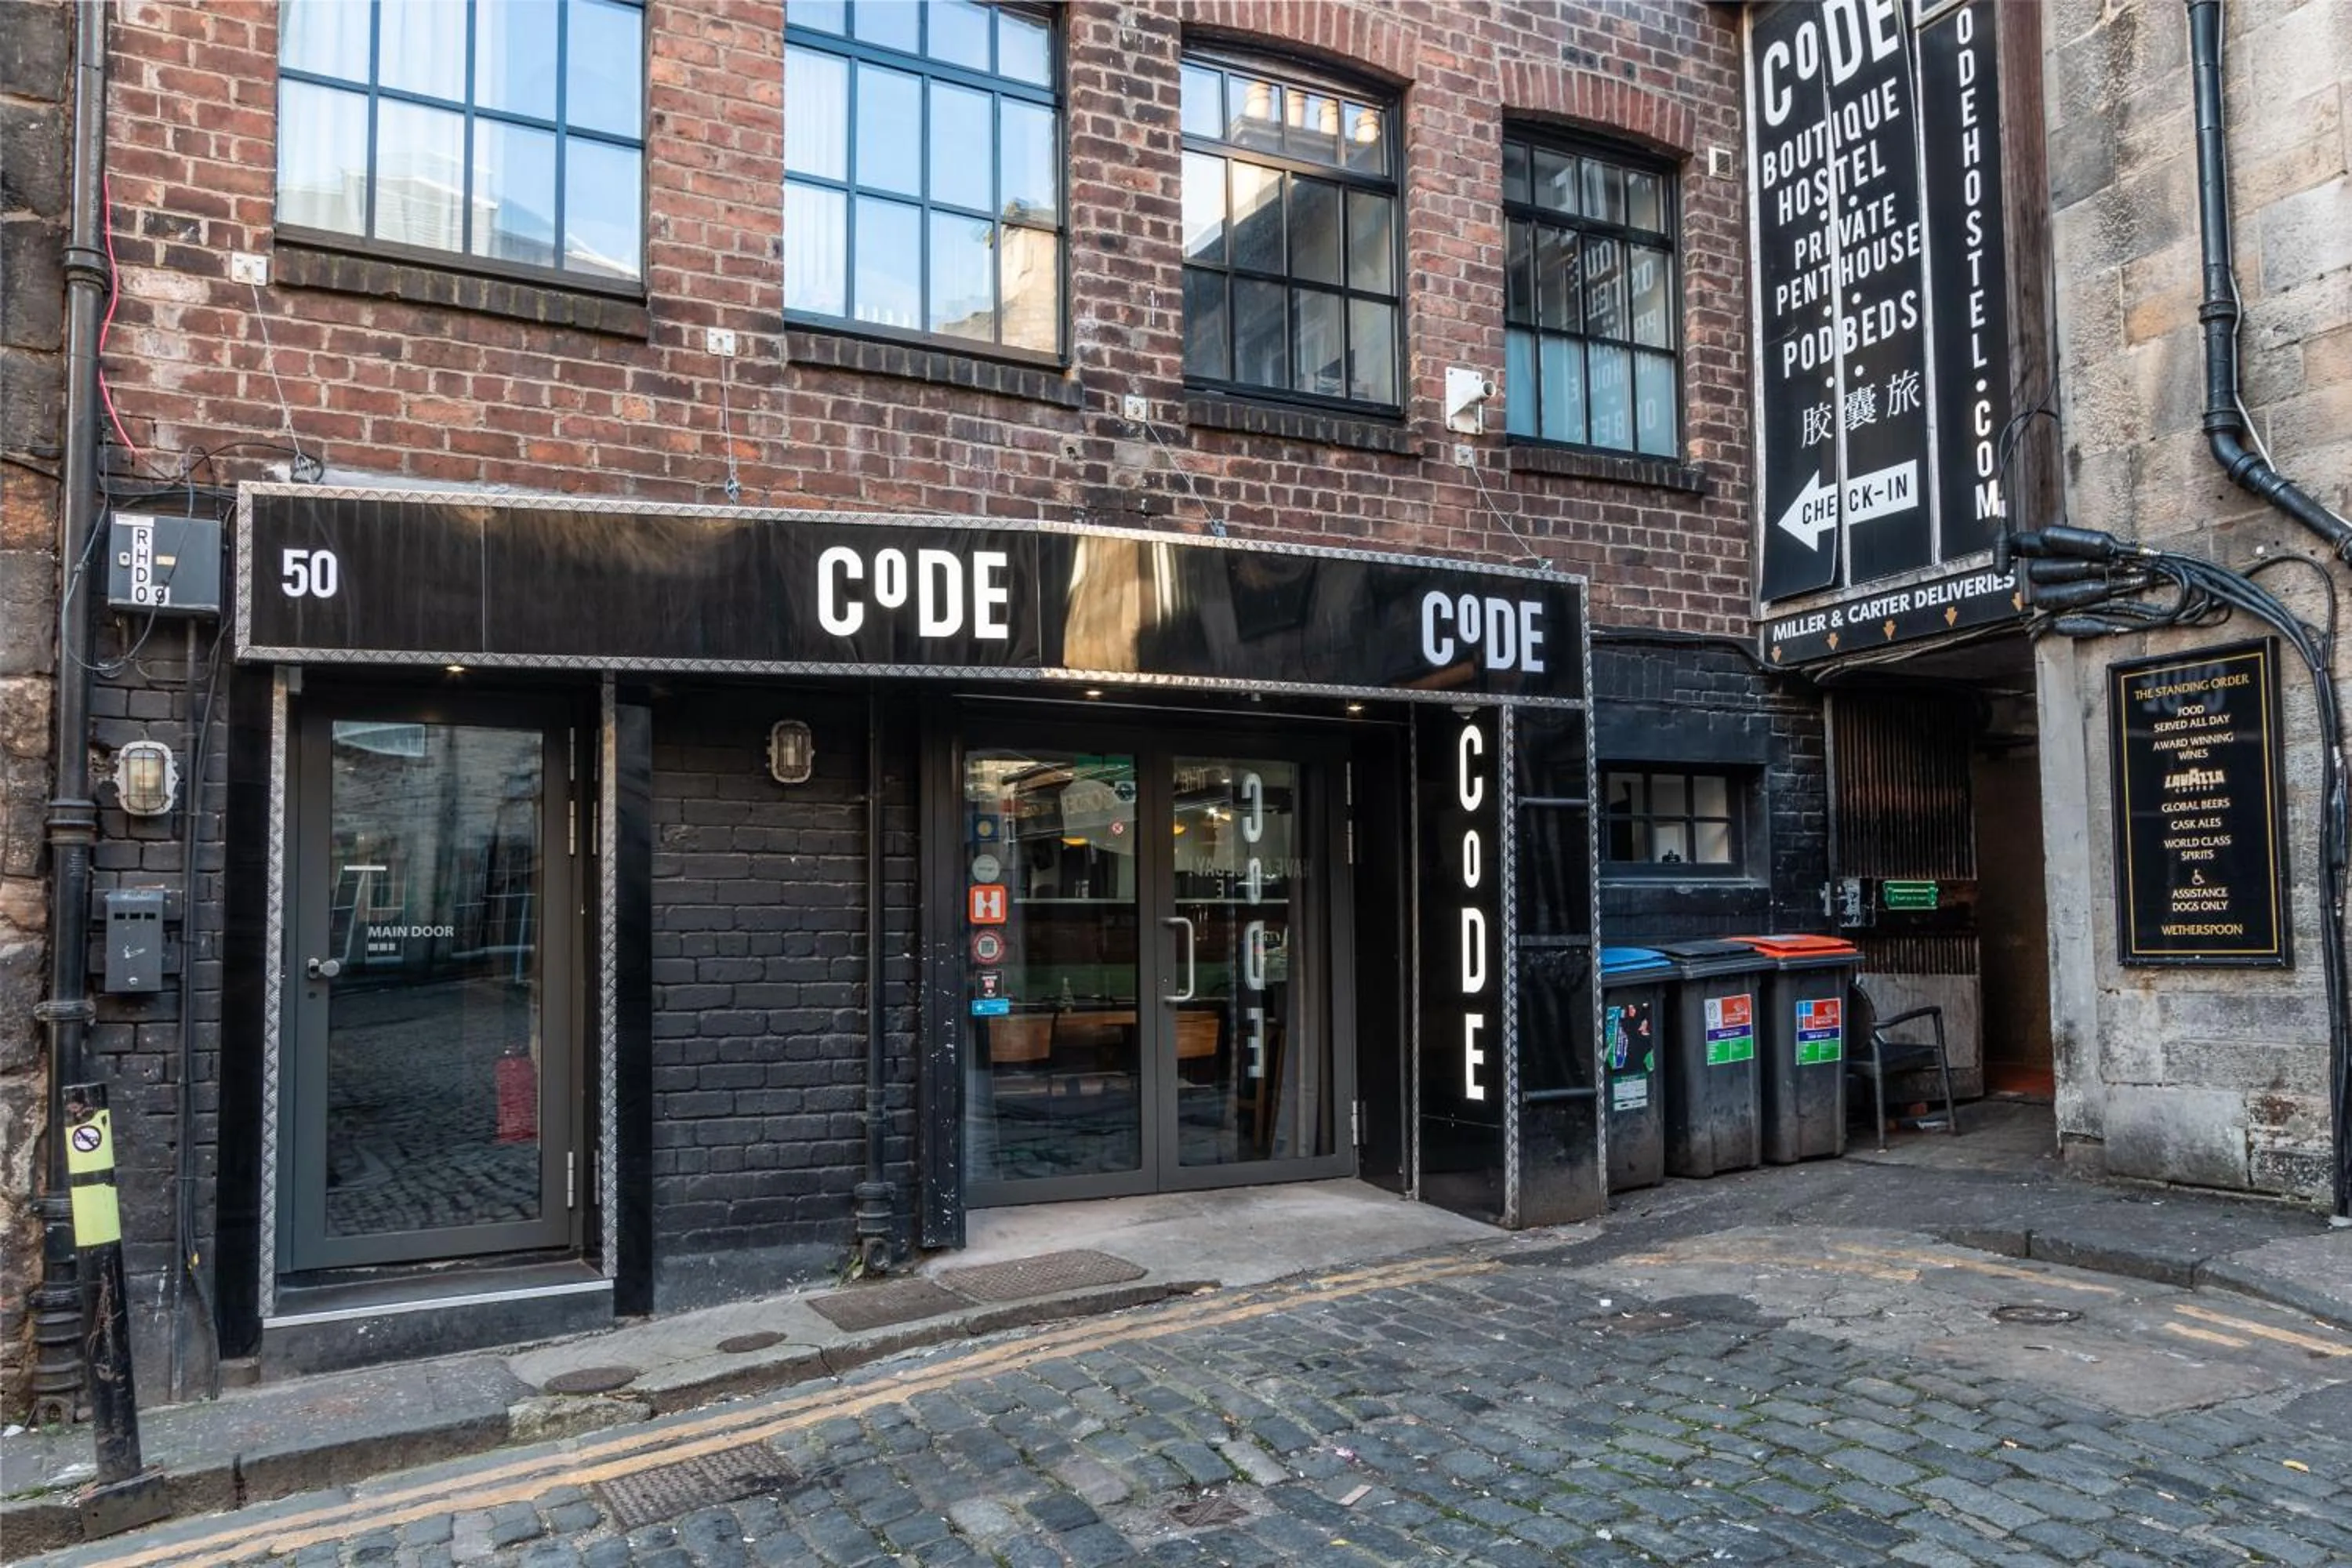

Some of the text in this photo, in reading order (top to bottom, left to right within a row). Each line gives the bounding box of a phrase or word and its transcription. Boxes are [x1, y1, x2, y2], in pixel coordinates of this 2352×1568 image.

[1762, 77, 1900, 190] BOUTIQUE
[1777, 139, 1886, 226] HOSTEL
[1794, 192, 1896, 270] PRIVATE
[1776, 222, 1921, 316] PENTHOUSE
[1802, 473, 1907, 525] CHECK-IN
[281, 549, 338, 598] 50
[817, 545, 1009, 639] CODE
[1773, 568, 2016, 642] MILLER & CARTER DELIVERIES
[1421, 590, 1545, 673] CODE
[2134, 673, 2249, 700] THE STANDING ORDER
[2177, 706, 2205, 717] FOOD
[2154, 714, 2230, 732] SERVED ALL DAY
[2153, 732, 2234, 751] AWARD WINNING
[2178, 749, 2209, 760] WINES
[2165, 768, 2224, 789] LAVAZZA
[2162, 798, 2230, 812] GLOBAL BEERS
[2172, 818, 2221, 830] CASK ALES
[2164, 836, 2231, 848] WORLD CLASS
[2181, 850, 2214, 861] SPIRITS
[2172, 887, 2229, 898] ASSISTANCE
[1459, 725, 1486, 1100] CODE
[2172, 901, 2228, 912] DOGS ONLY
[368, 926, 454, 938] MAIN DOOR
[2161, 924, 2243, 935] WETHERSPOON
